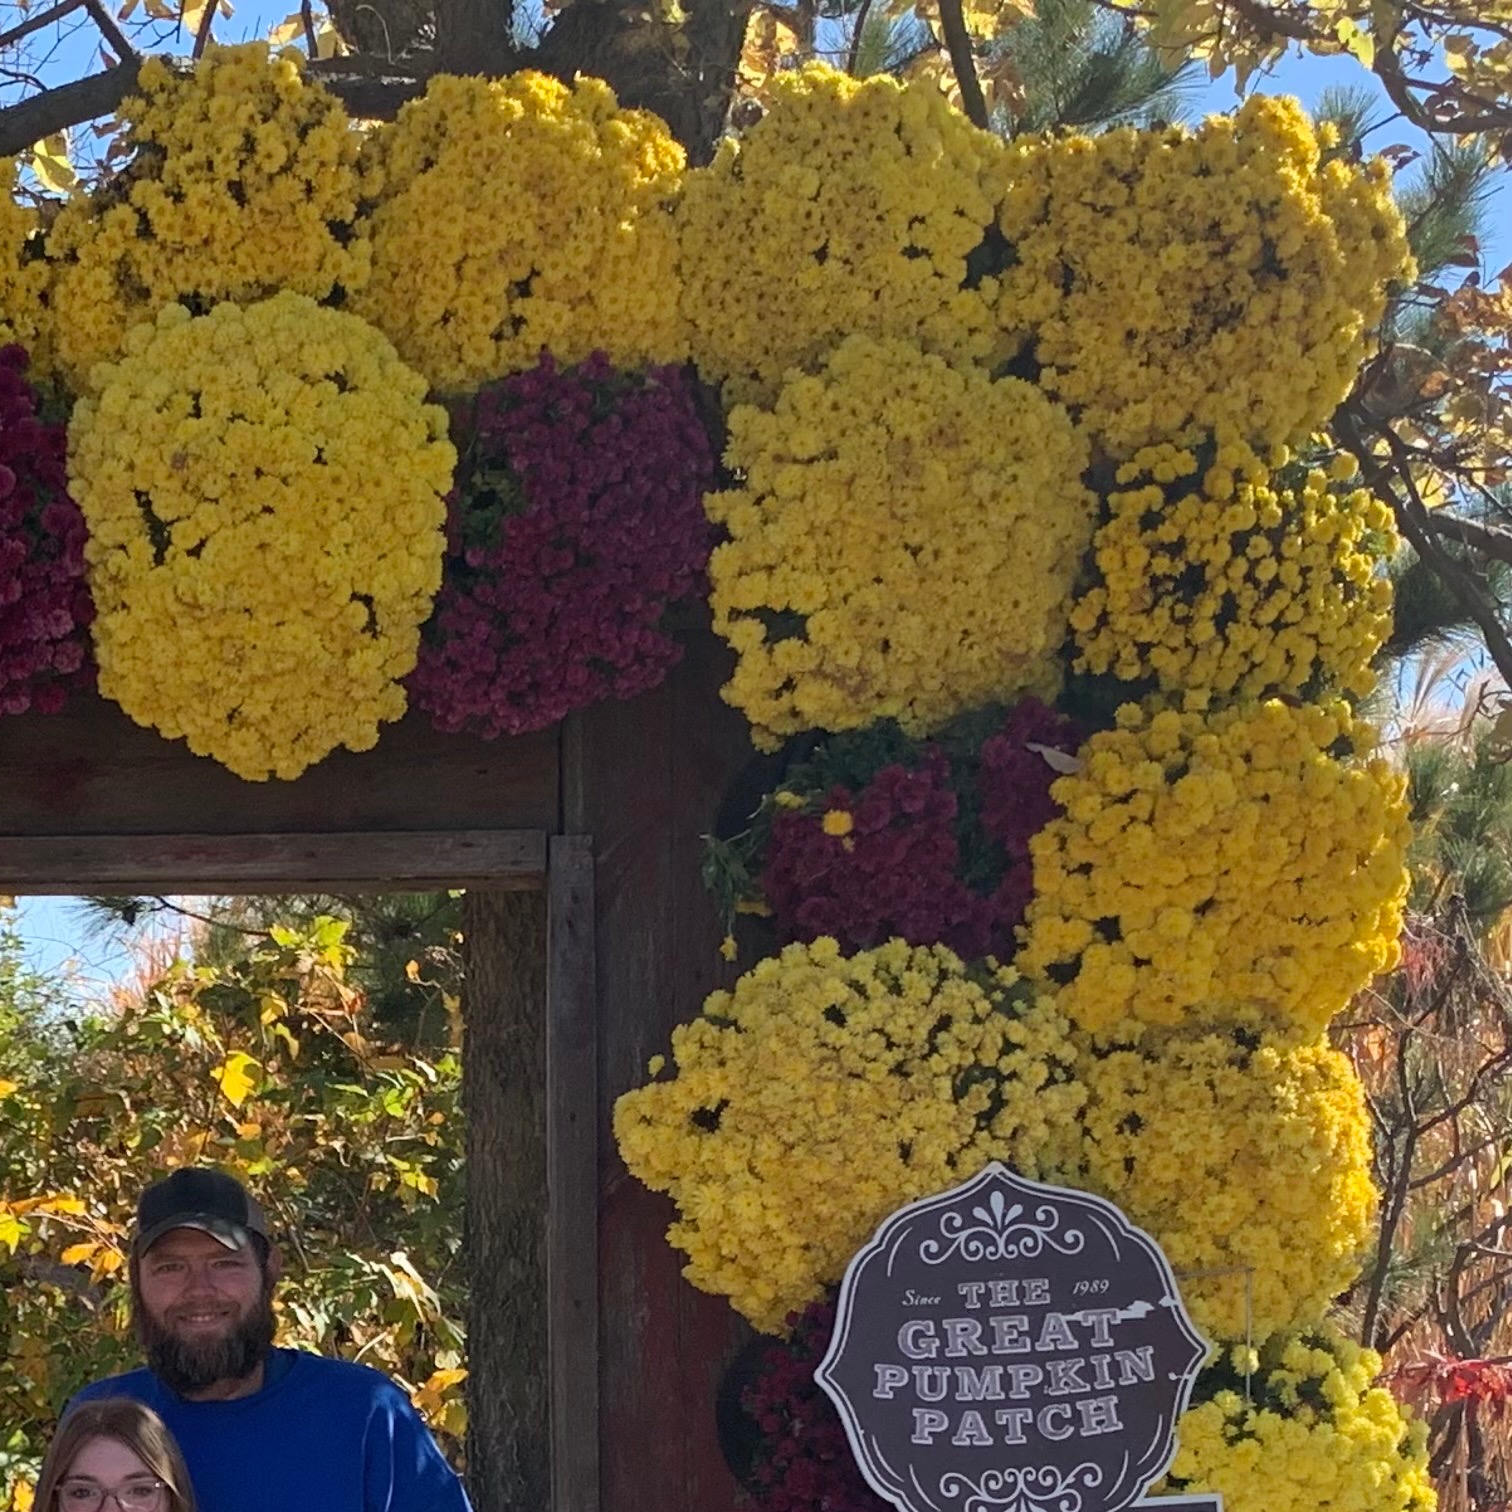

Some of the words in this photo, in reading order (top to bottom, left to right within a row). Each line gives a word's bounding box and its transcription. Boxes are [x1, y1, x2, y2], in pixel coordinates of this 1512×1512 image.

[902, 1289, 942, 1306] Since
[958, 1278, 1051, 1309] THE
[1072, 1279, 1110, 1296] 1989
[897, 1308, 1121, 1359] GREAT
[873, 1346, 1157, 1401] PUMPKIN
[911, 1395, 1124, 1447] PATCH
